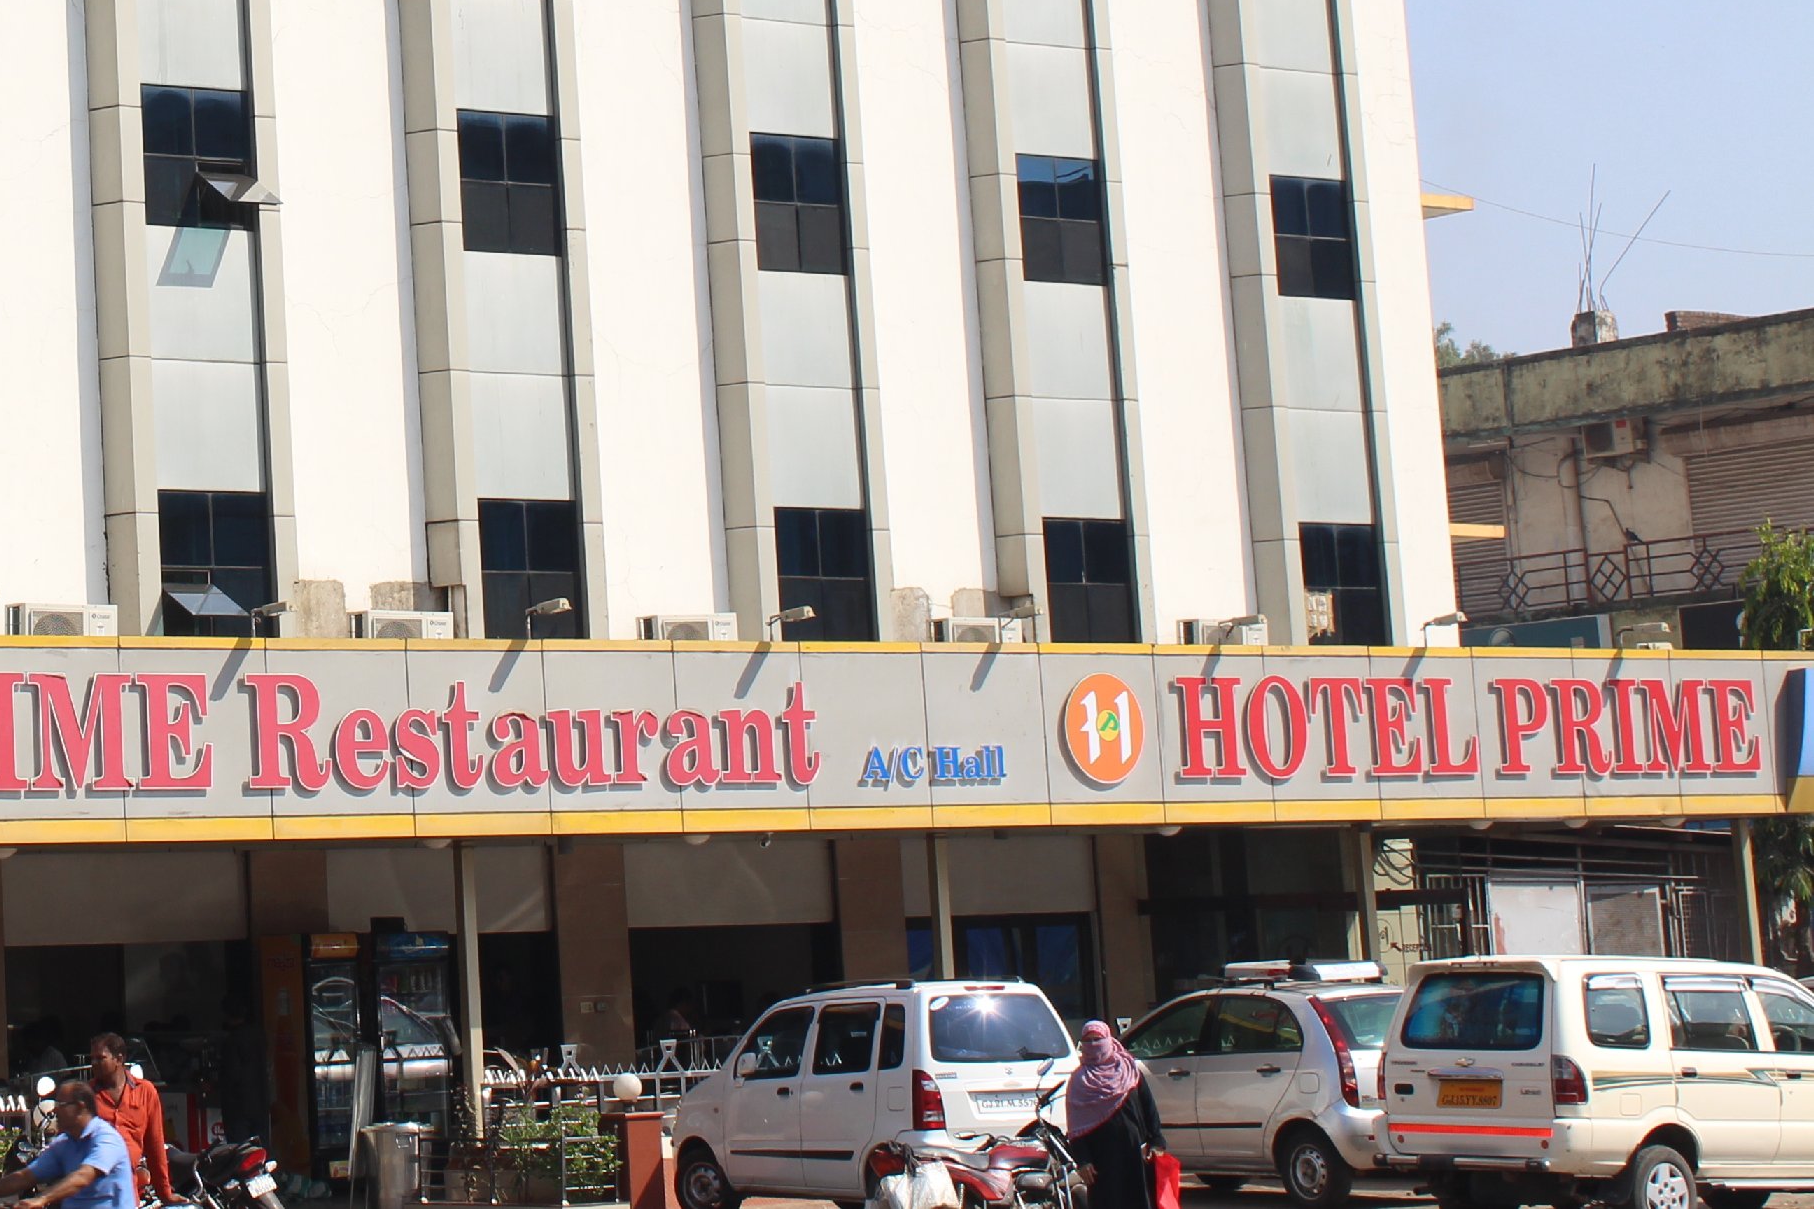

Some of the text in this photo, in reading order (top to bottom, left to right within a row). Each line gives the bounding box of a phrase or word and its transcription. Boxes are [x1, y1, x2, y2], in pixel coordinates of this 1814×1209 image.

[244, 672, 821, 791] Restaurant
[864, 745, 1006, 784] A/C Hall
[1174, 675, 1762, 779] HOTEL PRIME
